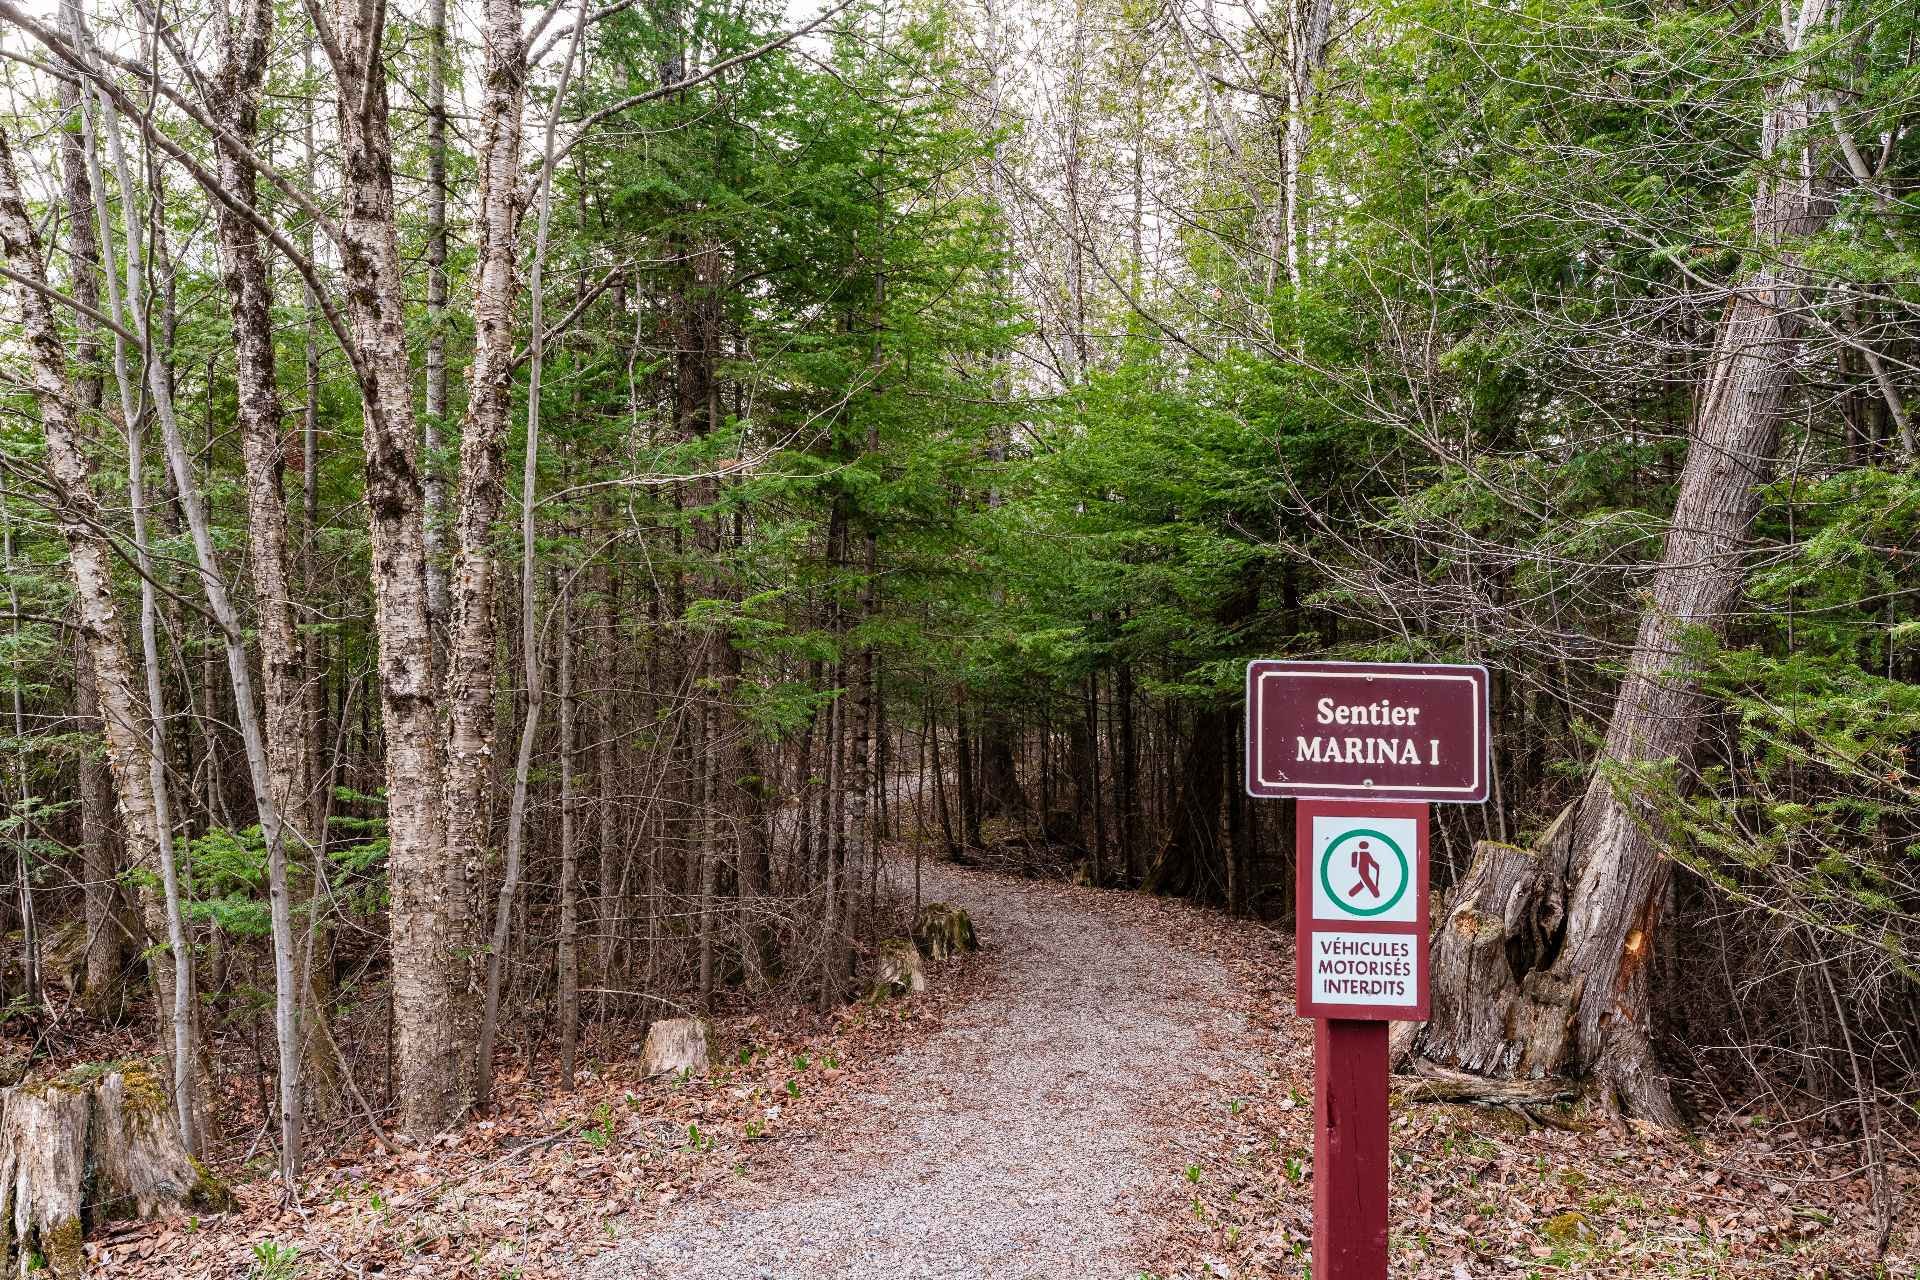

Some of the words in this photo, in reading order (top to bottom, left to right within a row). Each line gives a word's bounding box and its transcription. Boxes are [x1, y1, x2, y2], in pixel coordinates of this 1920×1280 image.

[1317, 697, 1420, 726] Sentier
[1296, 736, 1421, 765] MARINA
[1320, 937, 1409, 957] VÉHICULES
[1318, 958, 1411, 976] MOTORISÉS
[1323, 979, 1405, 996] INTERDITS
